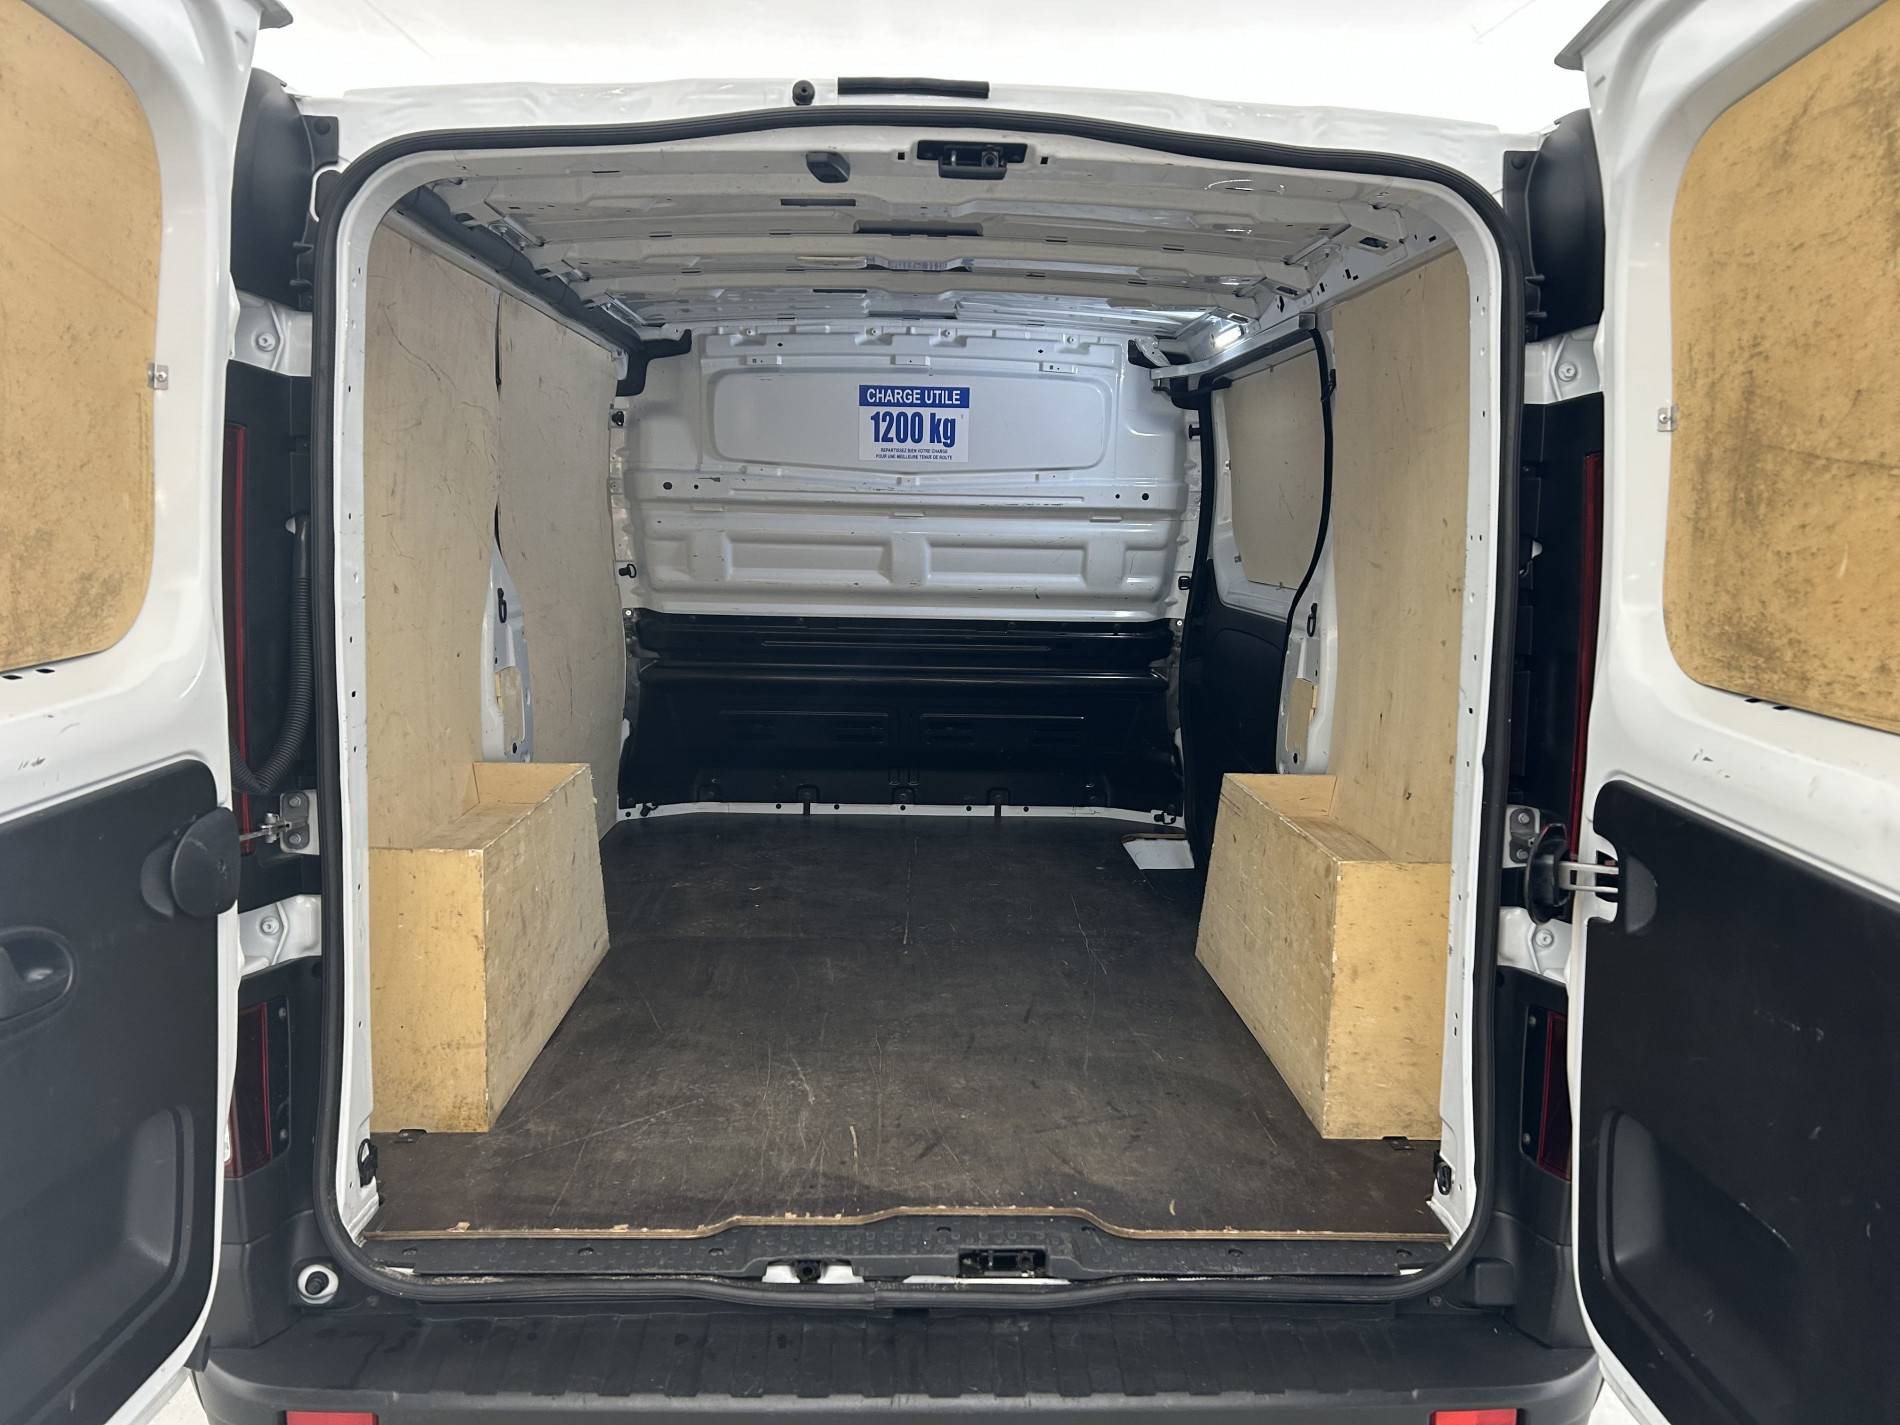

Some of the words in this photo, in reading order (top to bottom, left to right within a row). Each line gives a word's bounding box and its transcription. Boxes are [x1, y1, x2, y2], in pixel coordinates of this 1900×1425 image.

[867, 389, 921, 404] CHARGE
[925, 390, 961, 405] UTILE
[870, 411, 924, 444] 1200
[929, 412, 956, 448] kg
